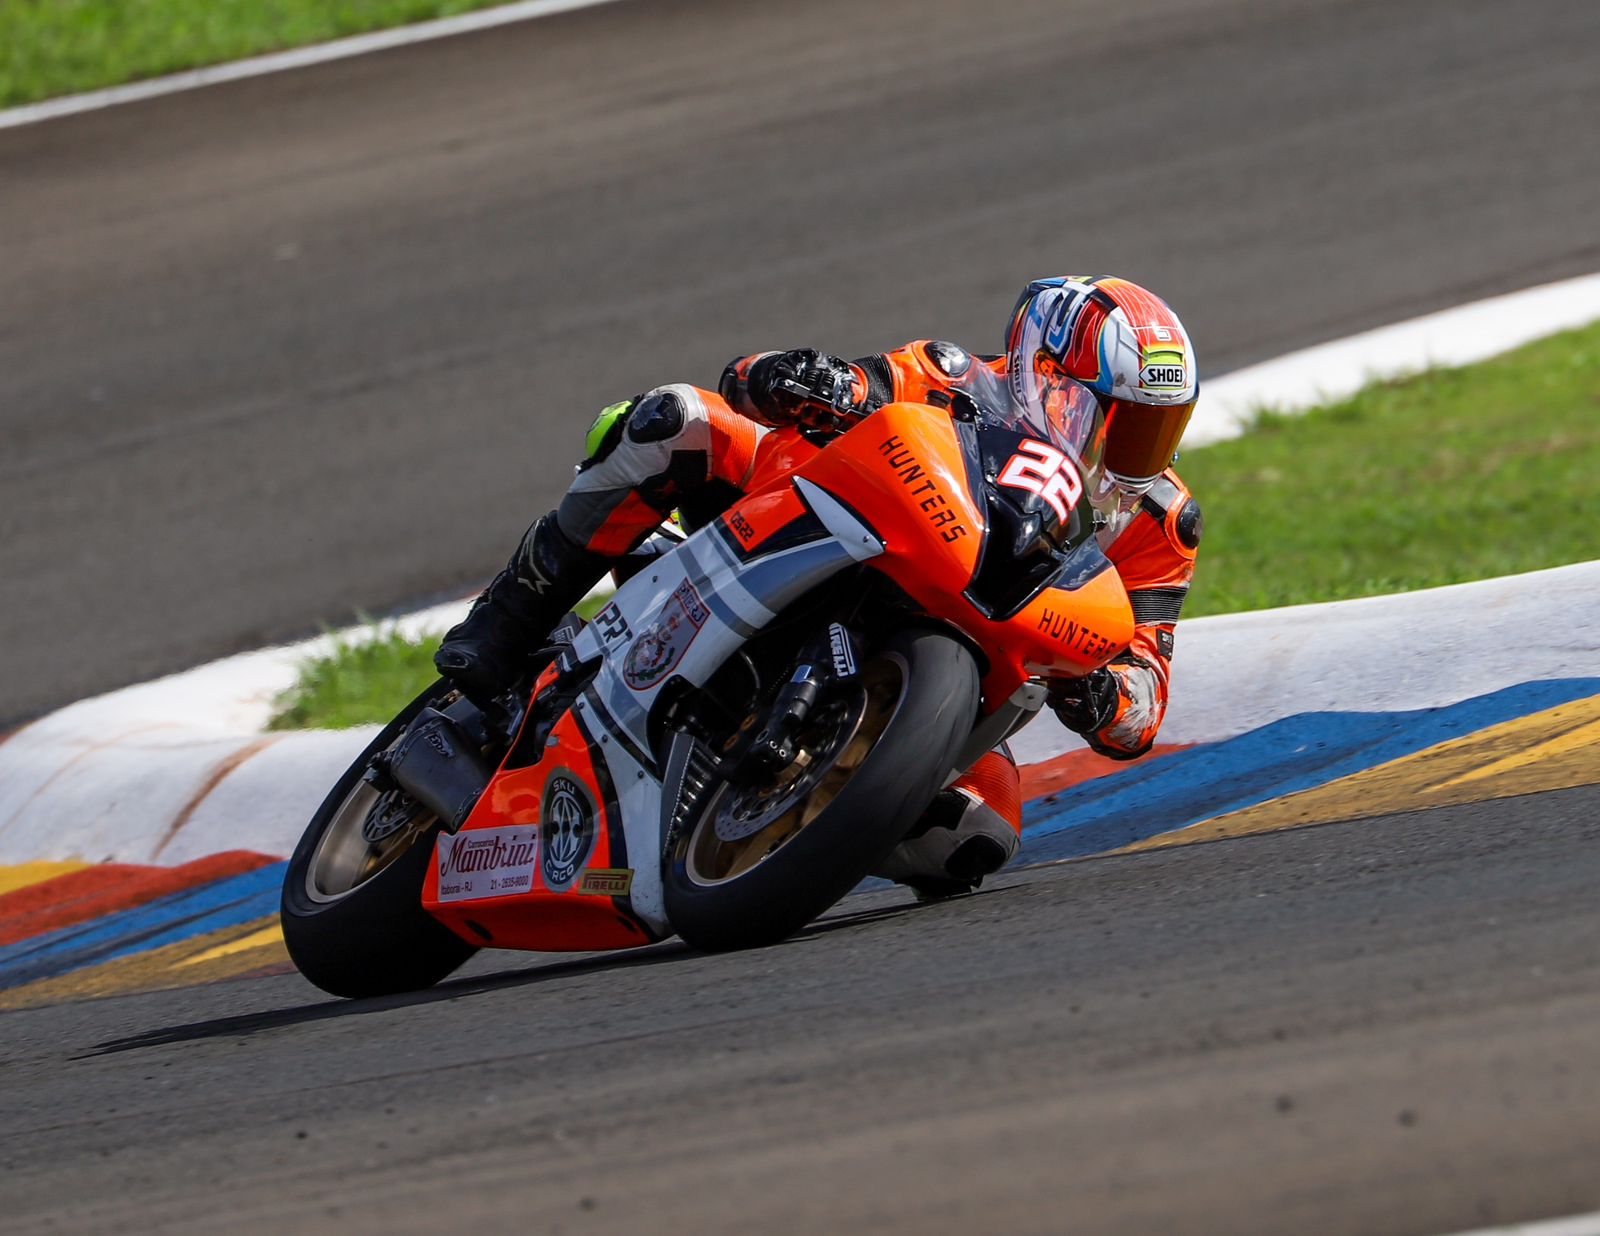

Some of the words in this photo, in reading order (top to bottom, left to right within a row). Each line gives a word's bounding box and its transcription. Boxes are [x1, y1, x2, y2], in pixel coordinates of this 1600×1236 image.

[1148, 368, 1183, 383] SHOEI
[879, 435, 967, 543] HUNTERS
[997, 438, 1083, 526] 22
[441, 833, 536, 877] Mambrini
